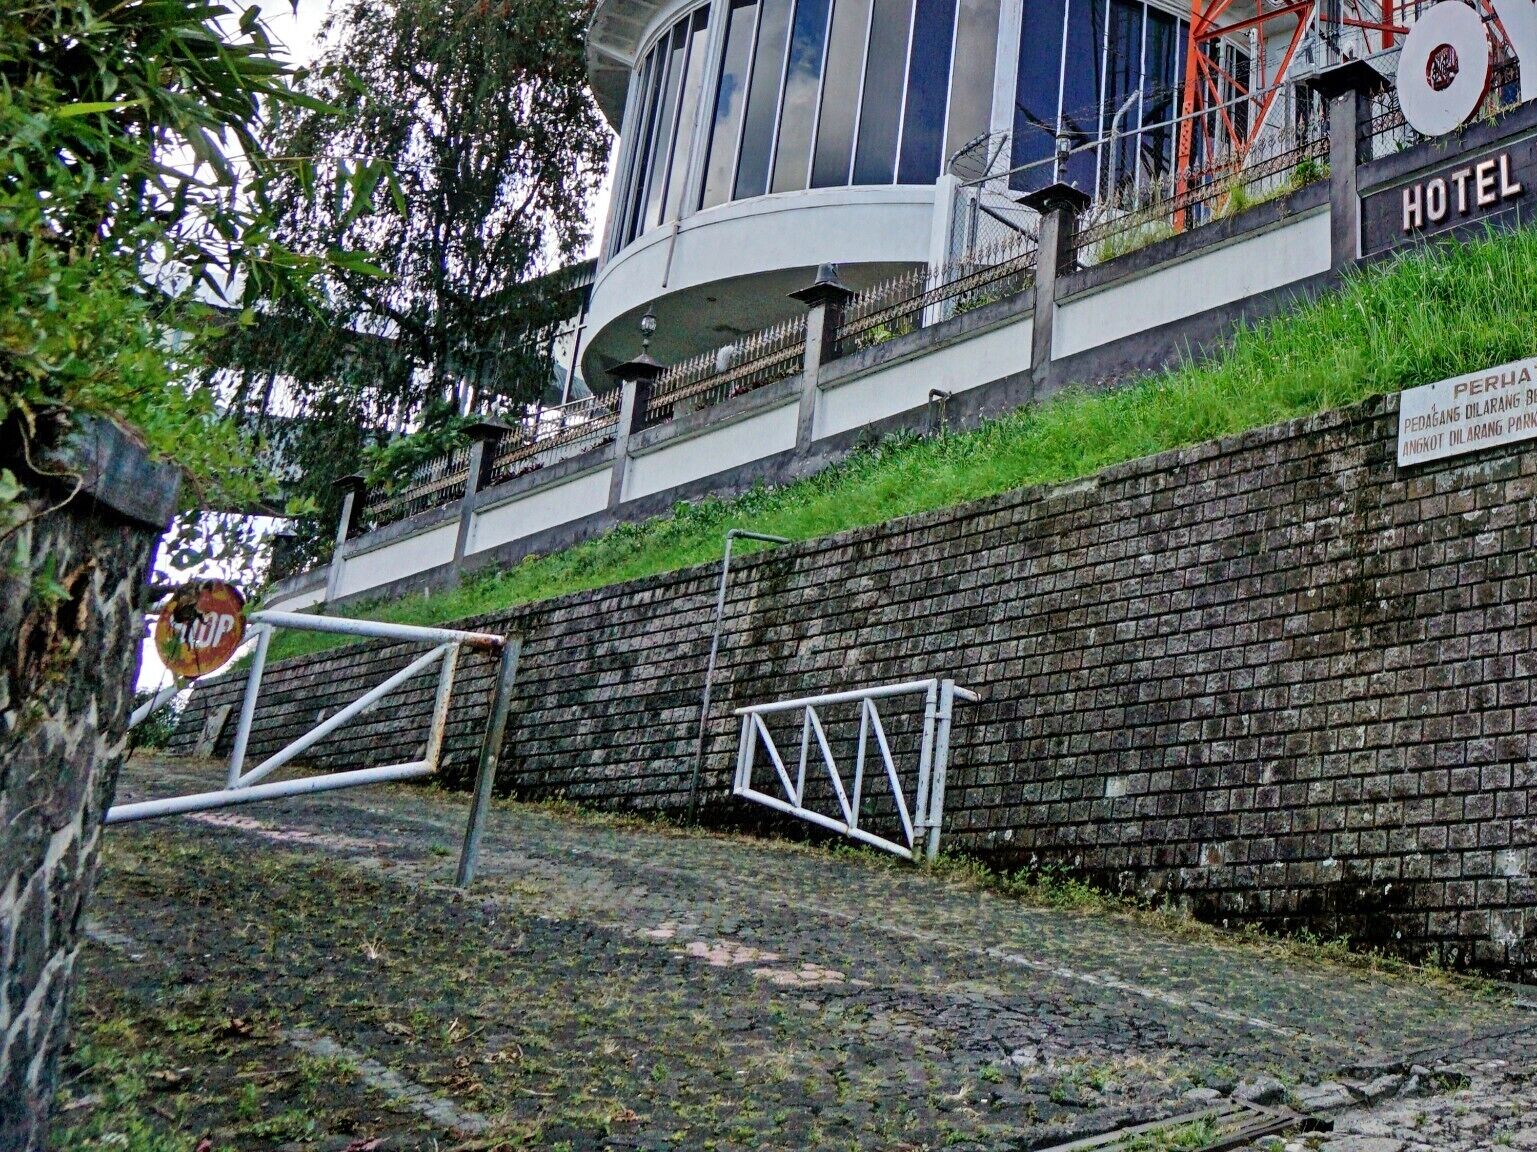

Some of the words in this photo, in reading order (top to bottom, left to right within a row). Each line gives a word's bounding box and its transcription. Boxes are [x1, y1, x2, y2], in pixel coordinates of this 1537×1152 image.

[1402, 152, 1522, 233] HOTEL
[1404, 406, 1461, 434] PEDAGANG
[1465, 392, 1521, 420] DILARANG
[1402, 432, 1446, 457] ANGKOT
[1449, 419, 1504, 447] DILARANG
